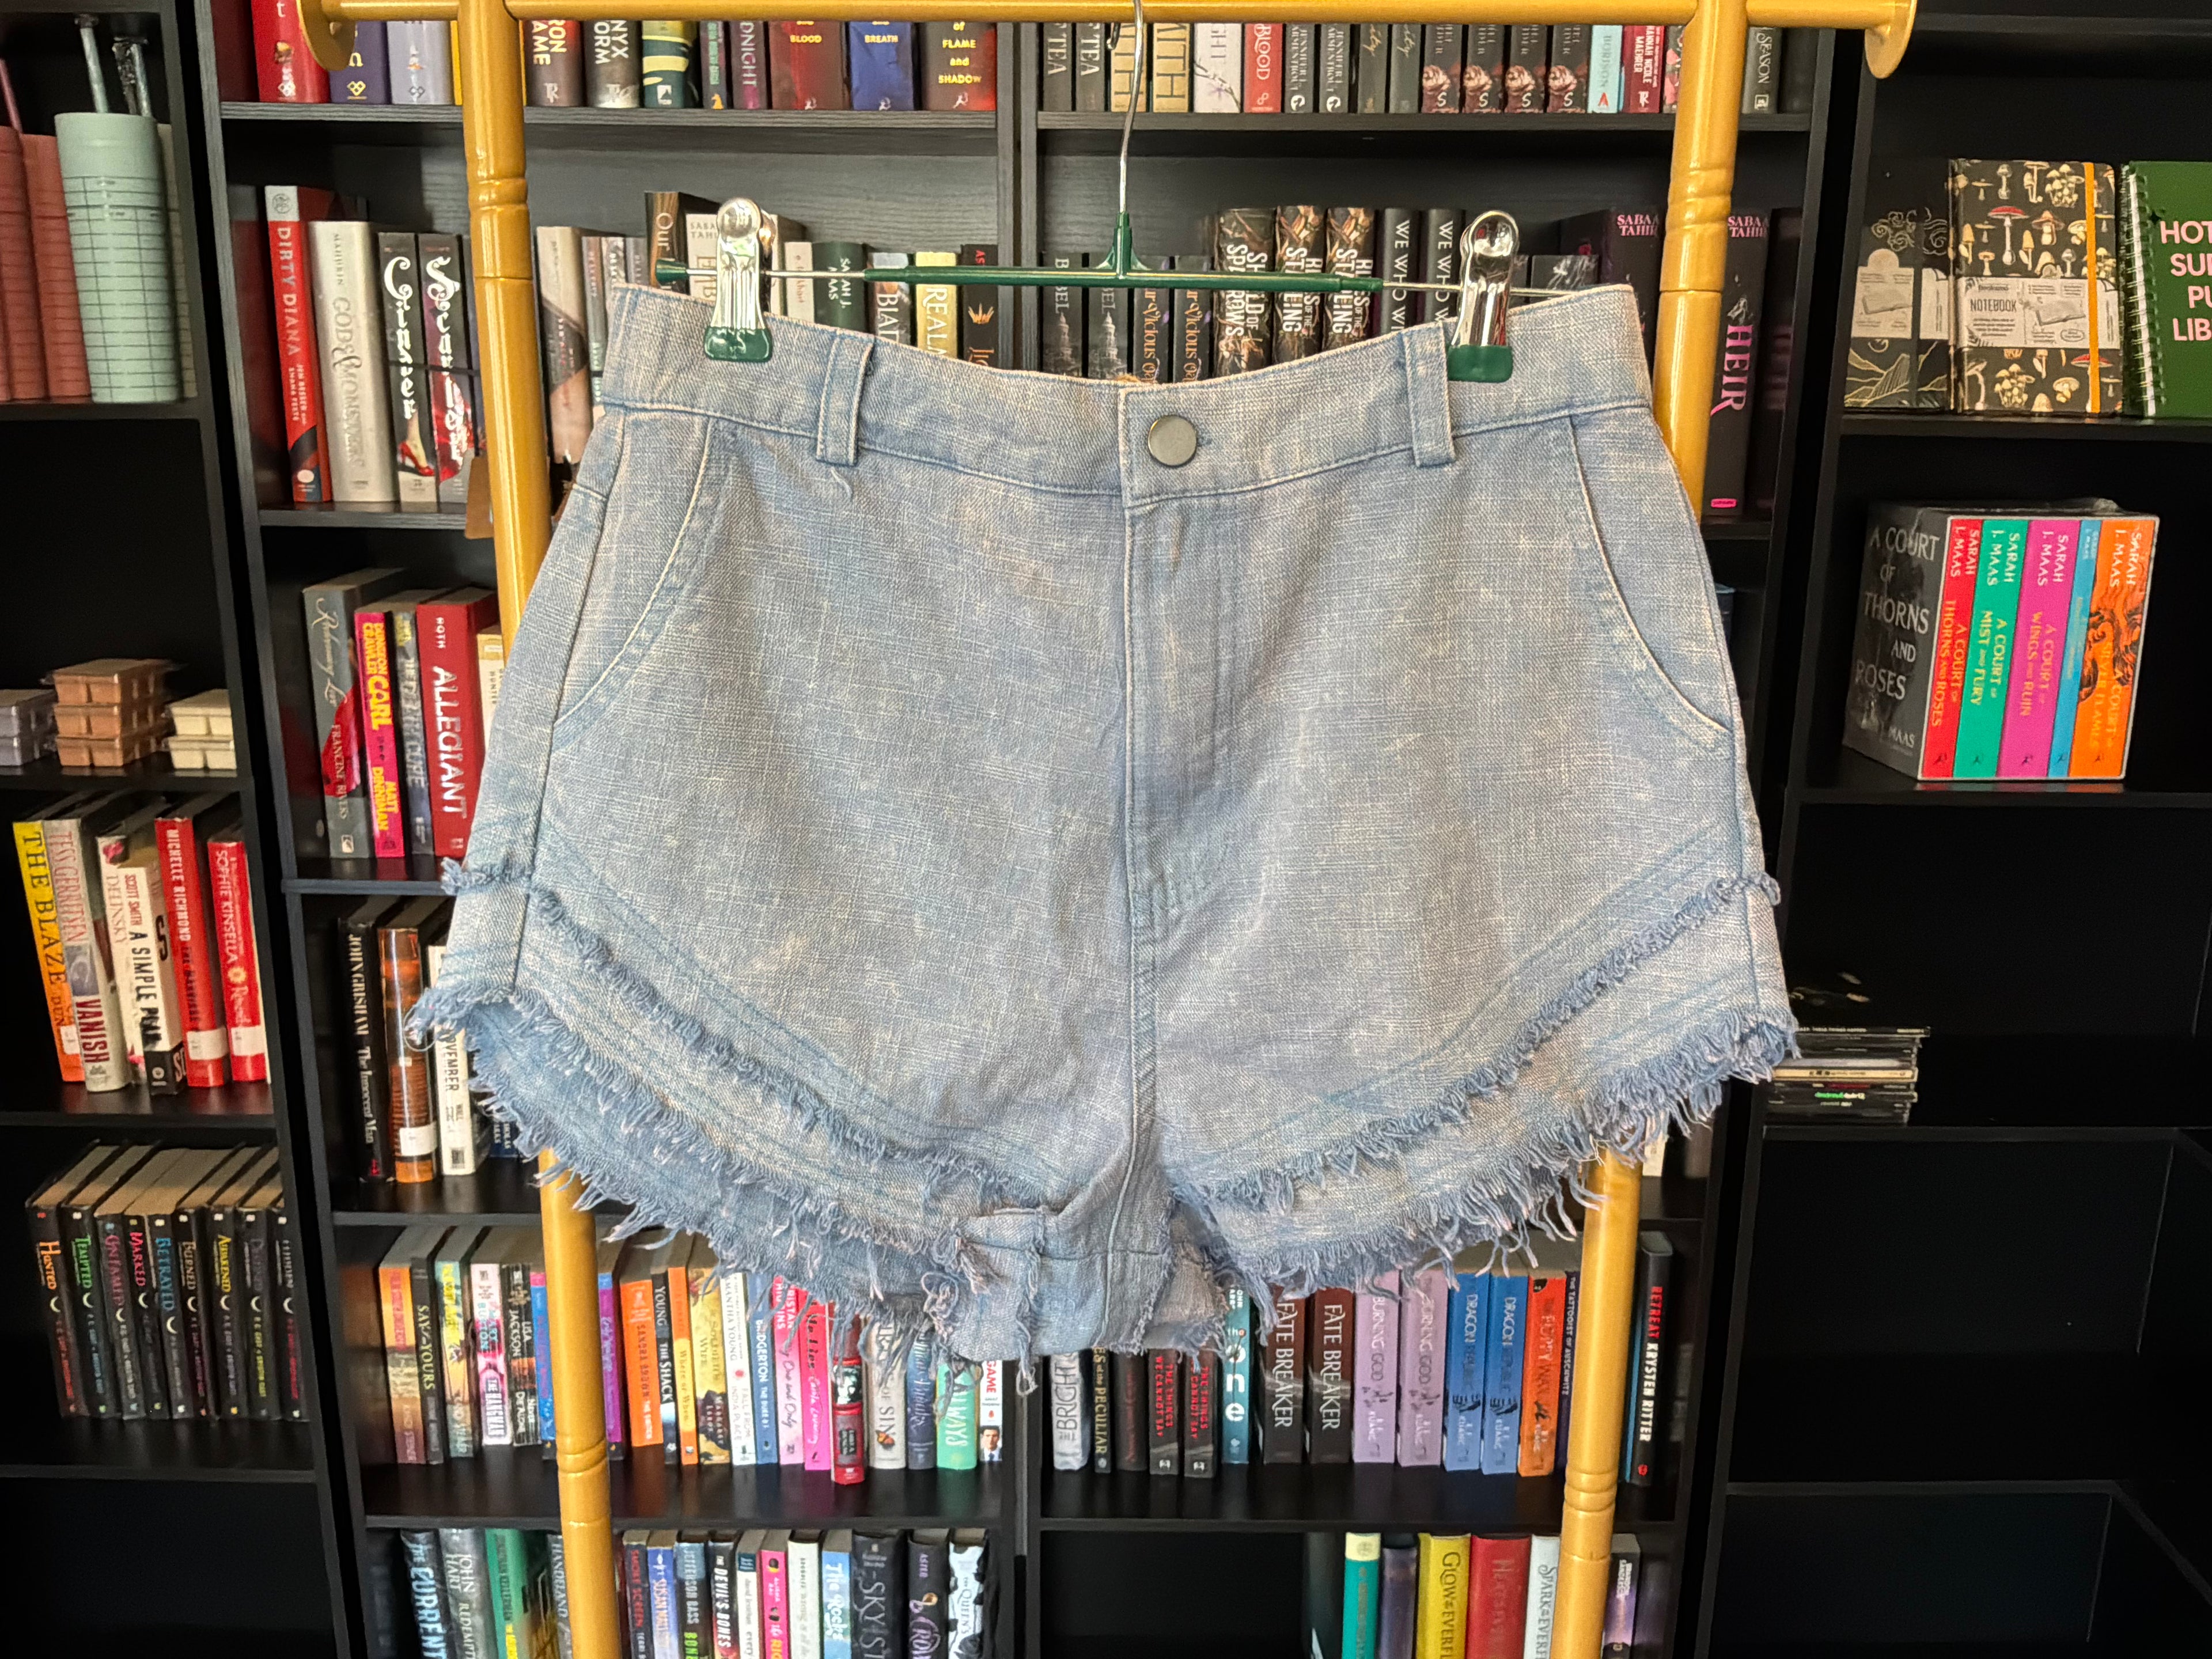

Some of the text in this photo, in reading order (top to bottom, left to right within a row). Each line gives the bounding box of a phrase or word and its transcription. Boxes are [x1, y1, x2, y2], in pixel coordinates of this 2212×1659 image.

[532, 21, 550, 65] AME
[549, 20, 567, 52] RON
[594, 21, 611, 64] ORM
[610, 20, 628, 58] NYX
[790, 35, 822, 43] BLOOD
[865, 35, 898, 43] BREATH
[942, 39, 976, 48] FLAME
[953, 22, 965, 31] of
[950, 58, 969, 66] and
[1048, 33, 1067, 75] TEA
[1081, 35, 1100, 75] TEA
[1254, 24, 1272, 80] BLOOD
[1290, 26, 1300, 90] ARMENTROUT
[1298, 29, 1308, 78] JENNIFER
[1326, 27, 1335, 92] ARMENTROUT
[1334, 31, 1344, 78] JENNIFER
[1634, 36, 1644, 73] MAEHRER
[1643, 58, 1653, 84] NICOLE
[1756, 32, 1772, 85] SEASON
[938, 75, 982, 84] SHADOW
[657, 212, 673, 252] Our
[1395, 220, 1410, 249] WE
[1438, 221, 1453, 249] WE
[2160, 220, 2212, 244] HOT
[333, 232, 344, 286] MAHURIN
[840, 257, 851, 296] SAAH
[278, 227, 301, 357] DIRTY DIANA
[1225, 244, 1248, 336] SPROWS
[1245, 253, 1268, 331] SHLD OF
[1282, 247, 1308, 332] STLING
[1332, 249, 1358, 333] STLING
[1970, 298, 2017, 312] NOTEBOOK
[923, 287, 948, 355] REAL
[1143, 303, 1161, 359] Vicious
[1185, 303, 1203, 359] Vicious
[1304, 315, 1313, 327] THE
[1354, 317, 1363, 329] THE
[1710, 325, 1753, 418] HEIR
[1870, 526, 1940, 562] A COURT
[1950, 538, 1965, 578] MAAS
[1965, 529, 1980, 575] SARAH
[1987, 530, 2005, 586] J. MAAS
[2003, 532, 2020, 582] SARAH
[2037, 531, 2054, 586] J. MAAS
[2053, 534, 2069, 582] SARAH
[2109, 543, 2124, 588] MAAS
[2126, 532, 2142, 585] SARAH
[436, 617, 446, 649] ROTH
[1863, 590, 1930, 634] THORNS
[363, 622, 377, 675] CRAWLER
[376, 622, 388, 675] DUNGEON
[1891, 639, 1916, 662] AND
[1931, 599, 1956, 726] THORNS ROSES
[1950, 624, 1968, 688] A COURT
[1969, 611, 1993, 706] MIST FURY
[1990, 618, 2008, 685] A COURT
[2016, 611, 2043, 717] WINGS RUIN
[2039, 624, 2058, 688] A COURT
[368, 675, 392, 731] CARL
[1855, 658, 1906, 700] ROSES
[2105, 668, 2125, 734] A COURT
[331, 724, 345, 781] FRANCINE
[432, 666, 467, 819] ALLEGIANT
[385, 781, 399, 814] MATT
[22, 831, 67, 985] THE BLAZE
[48, 832, 88, 943] TESS GERRITSEN
[106, 874, 128, 944] DELINSKY
[124, 874, 140, 899] SCOTT
[166, 829, 191, 942] MICHELLE RICHMOND
[215, 850, 239, 964] SOPHIE KINSELLA
[128, 931, 148, 941] A
[131, 947, 157, 1002] SIMPLE
[348, 934, 369, 1036] JOHN GRISHAM
[75, 998, 110, 1063] VANISH
[357, 1046, 372, 1069] The
[444, 1036, 460, 1092] VEMBER
[364, 1119, 378, 1143] Man
[74, 1234, 93, 1289] TEMPTED
[129, 1232, 146, 1287] MARKED
[155, 1237, 175, 1312] BETRAYED
[509, 1309, 521, 1357] JACKSON
[724, 1276, 738, 1362] AMANTHA YOUNG
[1464, 1294, 1478, 1343] DRAGON
[1502, 1297, 1517, 1346] DRAGON
[1566, 1291, 1575, 1336] TATTOOIST
[416, 1304, 435, 1390] SAY YOURS
[654, 1286, 673, 1402] YOUNG THE SHACK
[1370, 1296, 1385, 1382] BURNING GOD
[1566, 1337, 1573, 1347] OF
[1639, 1286, 1664, 1442] RETREAT KRYSTEN RITTER
[783, 1360, 795, 1380] One
[986, 1361, 997, 1393] GAME
[1272, 1302, 1298, 1427] FATE BREAKER
[1319, 1304, 1346, 1430] FATE BREAKER
[1418, 1354, 1431, 1384] GOD
[1562, 1348, 1571, 1395] AUSCHWITZ
[485, 1392, 505, 1436] HANGMAN
[682, 1395, 690, 1421] When
[781, 1403, 797, 1428] Only
[1156, 1356, 1164, 1437] WE CANNOT SAY
[1165, 1363, 1174, 1427] THE THINGS
[1200, 1366, 1209, 1429] THE THINGS
[1094, 1387, 1108, 1454] PECULIAR
[445, 1554, 461, 1593] HART
[459, 1554, 475, 1593] JOHN
[683, 1549, 699, 1624] JEFFERSON BASS
[713, 1567, 730, 1609] DEVIL'S
[1439, 1551, 1461, 1601] GLOW
[1537, 1564, 1557, 1611] SPARK
[410, 1566, 447, 1659] CURRENT
[824, 1563, 847, 1641] The Rocks
[957, 1589, 972, 1635] QUEEN'S
[716, 1612, 732, 1648] BONES
